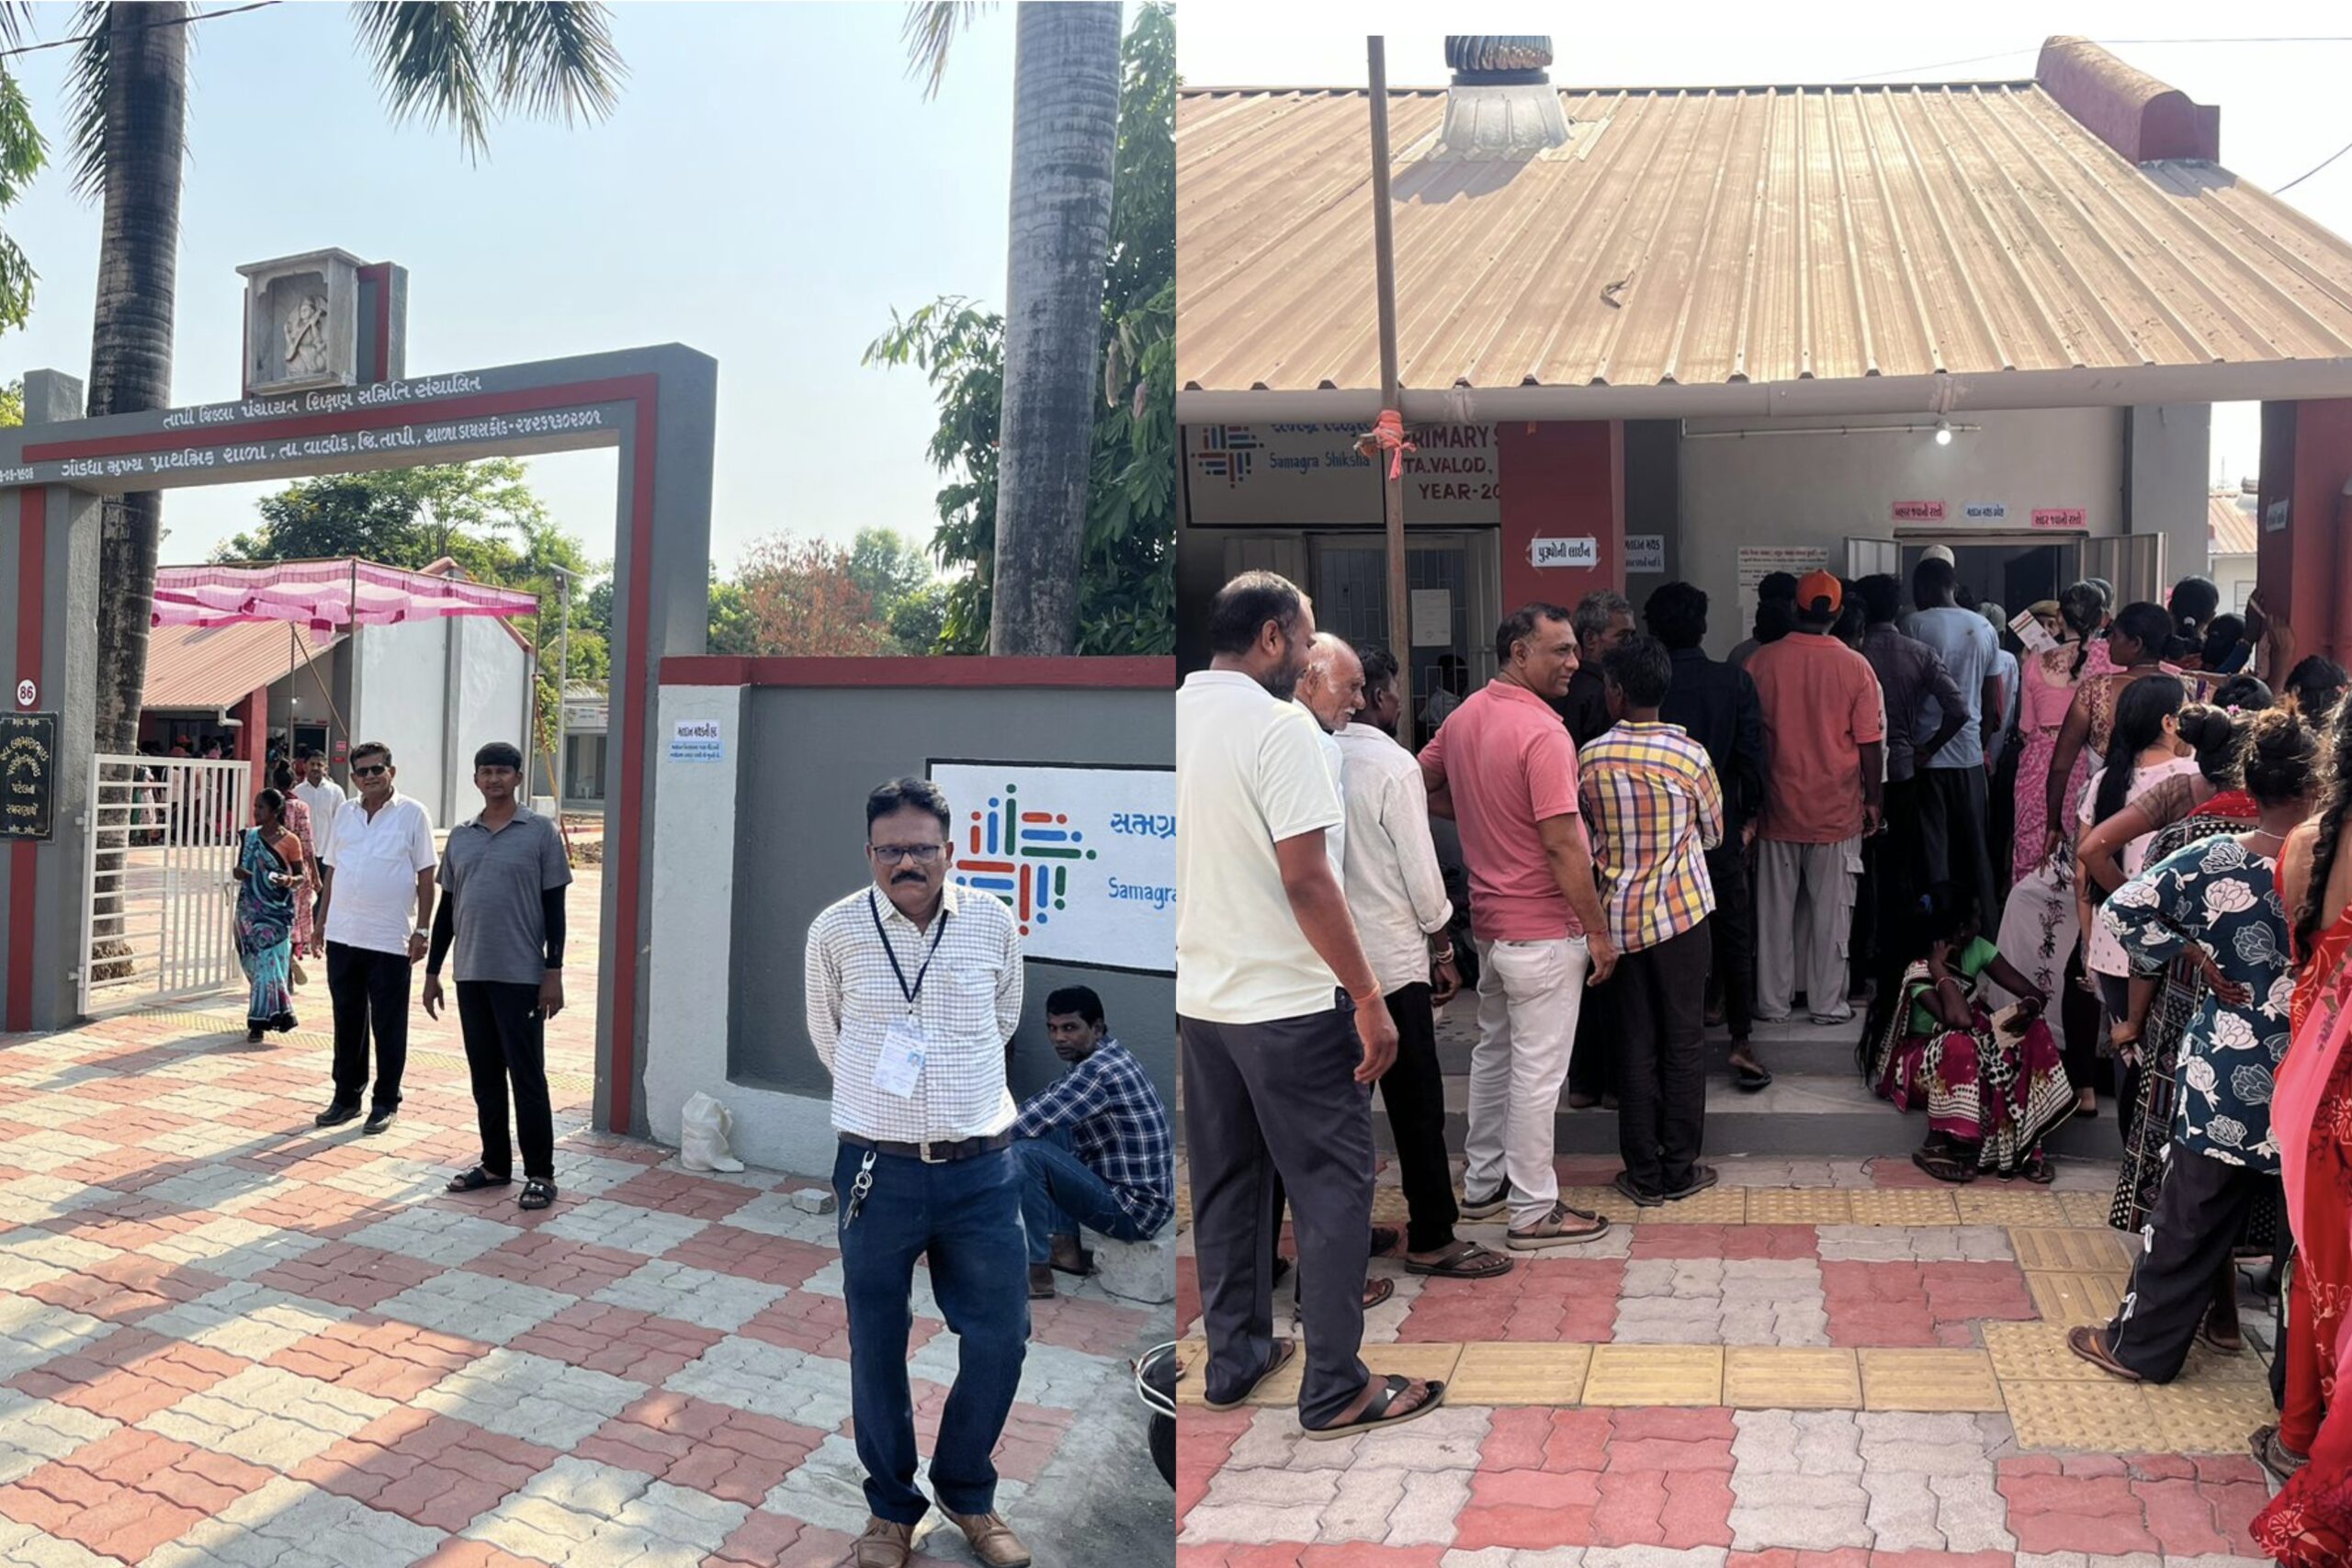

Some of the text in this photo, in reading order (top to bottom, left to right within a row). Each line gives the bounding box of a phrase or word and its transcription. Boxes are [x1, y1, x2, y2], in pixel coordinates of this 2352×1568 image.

[164, 407, 194, 429] તાપી
[241, 400, 298, 418] પંચાયત
[306, 391, 353, 412] શિક્ષણ
[357, 381, 411, 405] સમિતિ
[415, 373, 481, 398] સંચાલિત
[150, 448, 214, 472] પ્રાથમિક
[1270, 451, 1371, 475] Samagra Shiksha
[19, 685, 33, 699] 86
